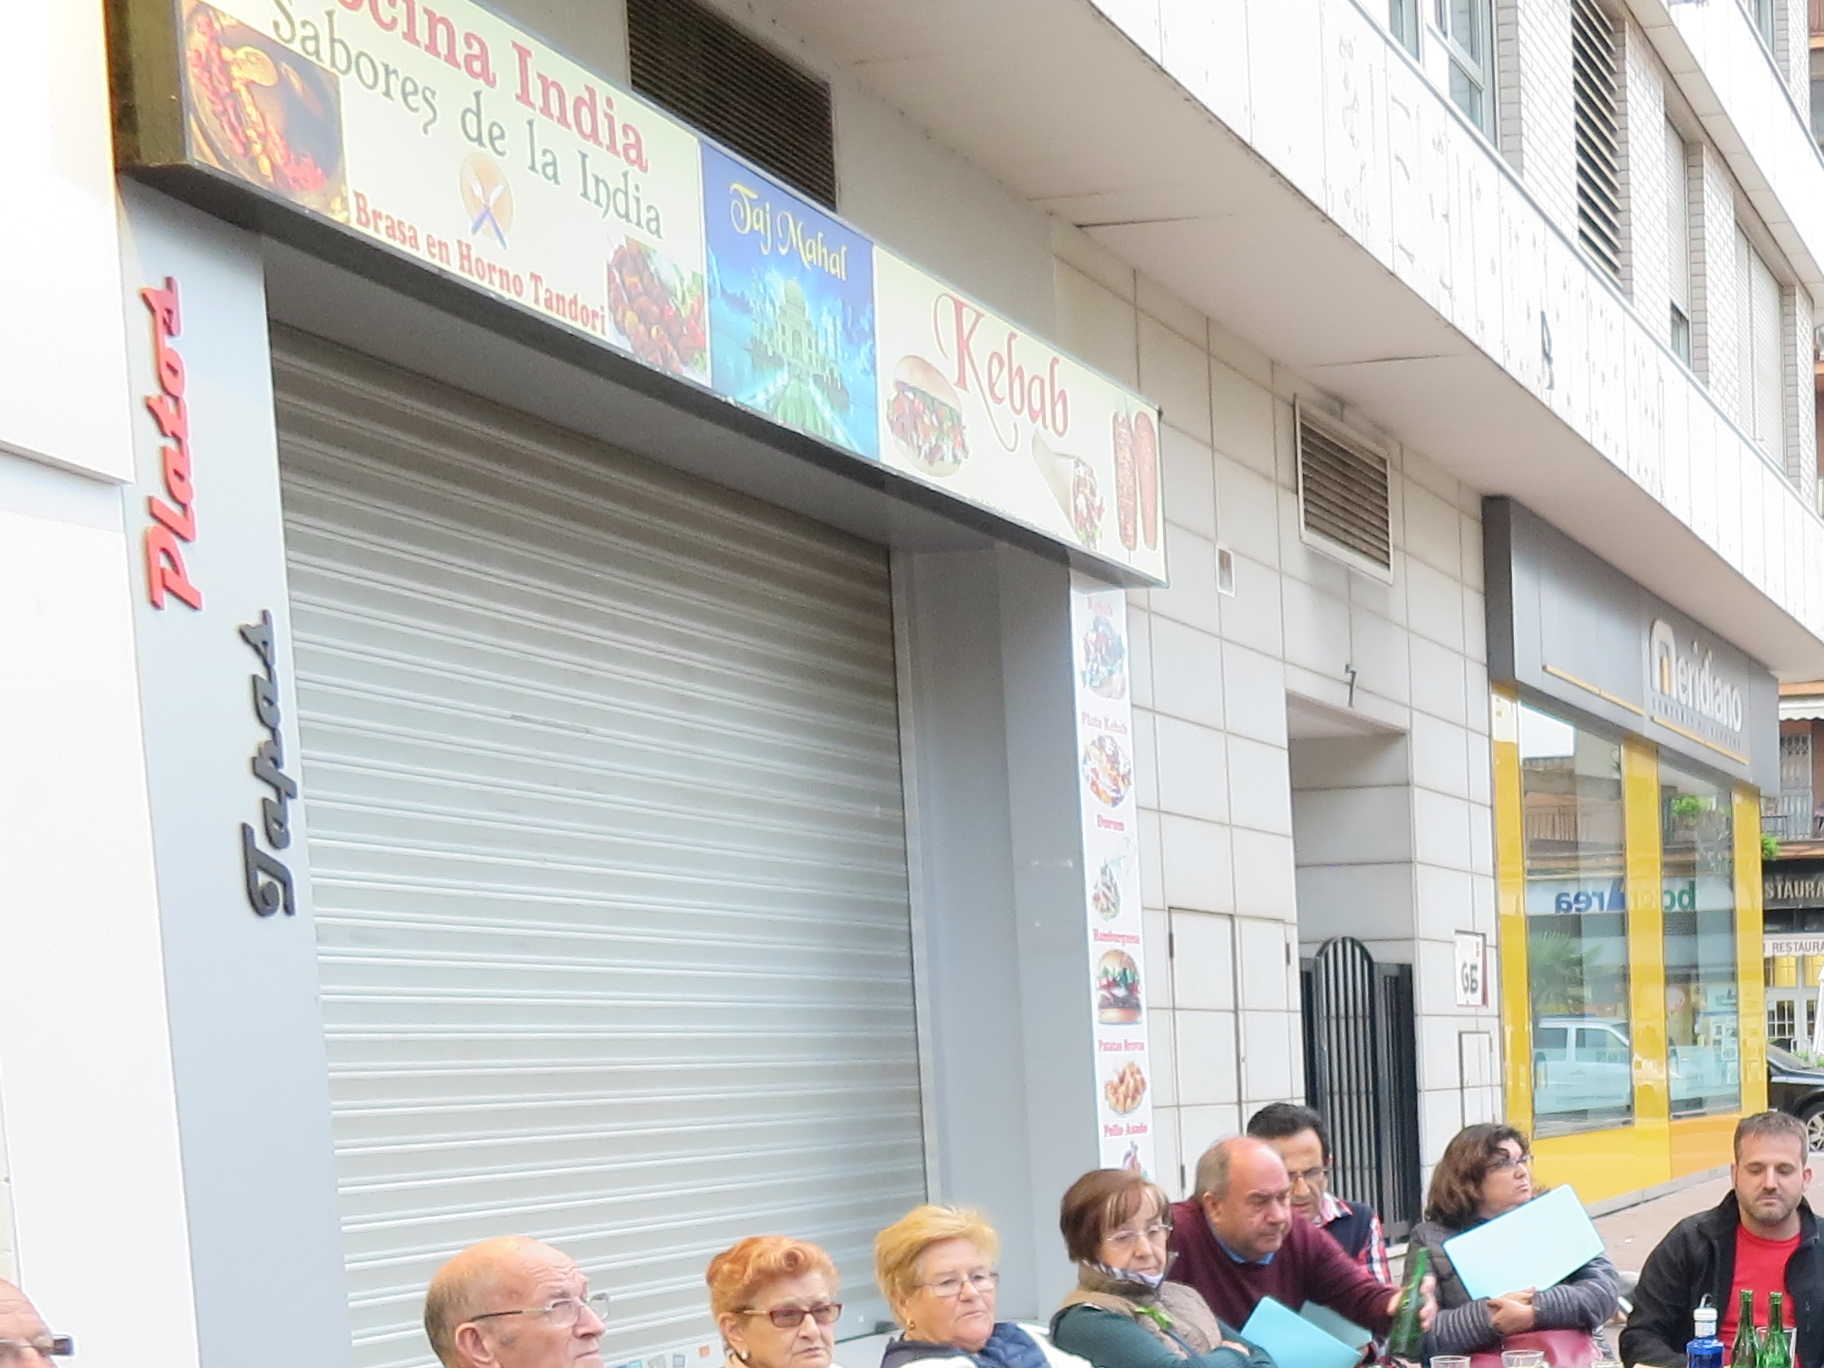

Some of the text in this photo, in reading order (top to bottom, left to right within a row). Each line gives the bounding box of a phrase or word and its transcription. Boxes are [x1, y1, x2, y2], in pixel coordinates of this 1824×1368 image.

[273, 0, 663, 239] Sabores de la India
[511, 40, 648, 173] India
[353, 191, 607, 336] Brasa en Horno Tandori
[729, 183, 848, 281] Taj Mahal
[141, 275, 202, 611] Platos
[933, 293, 1069, 452] Kebab
[1650, 618, 1743, 733] Meridiano
[240, 609, 297, 917] Tapas
